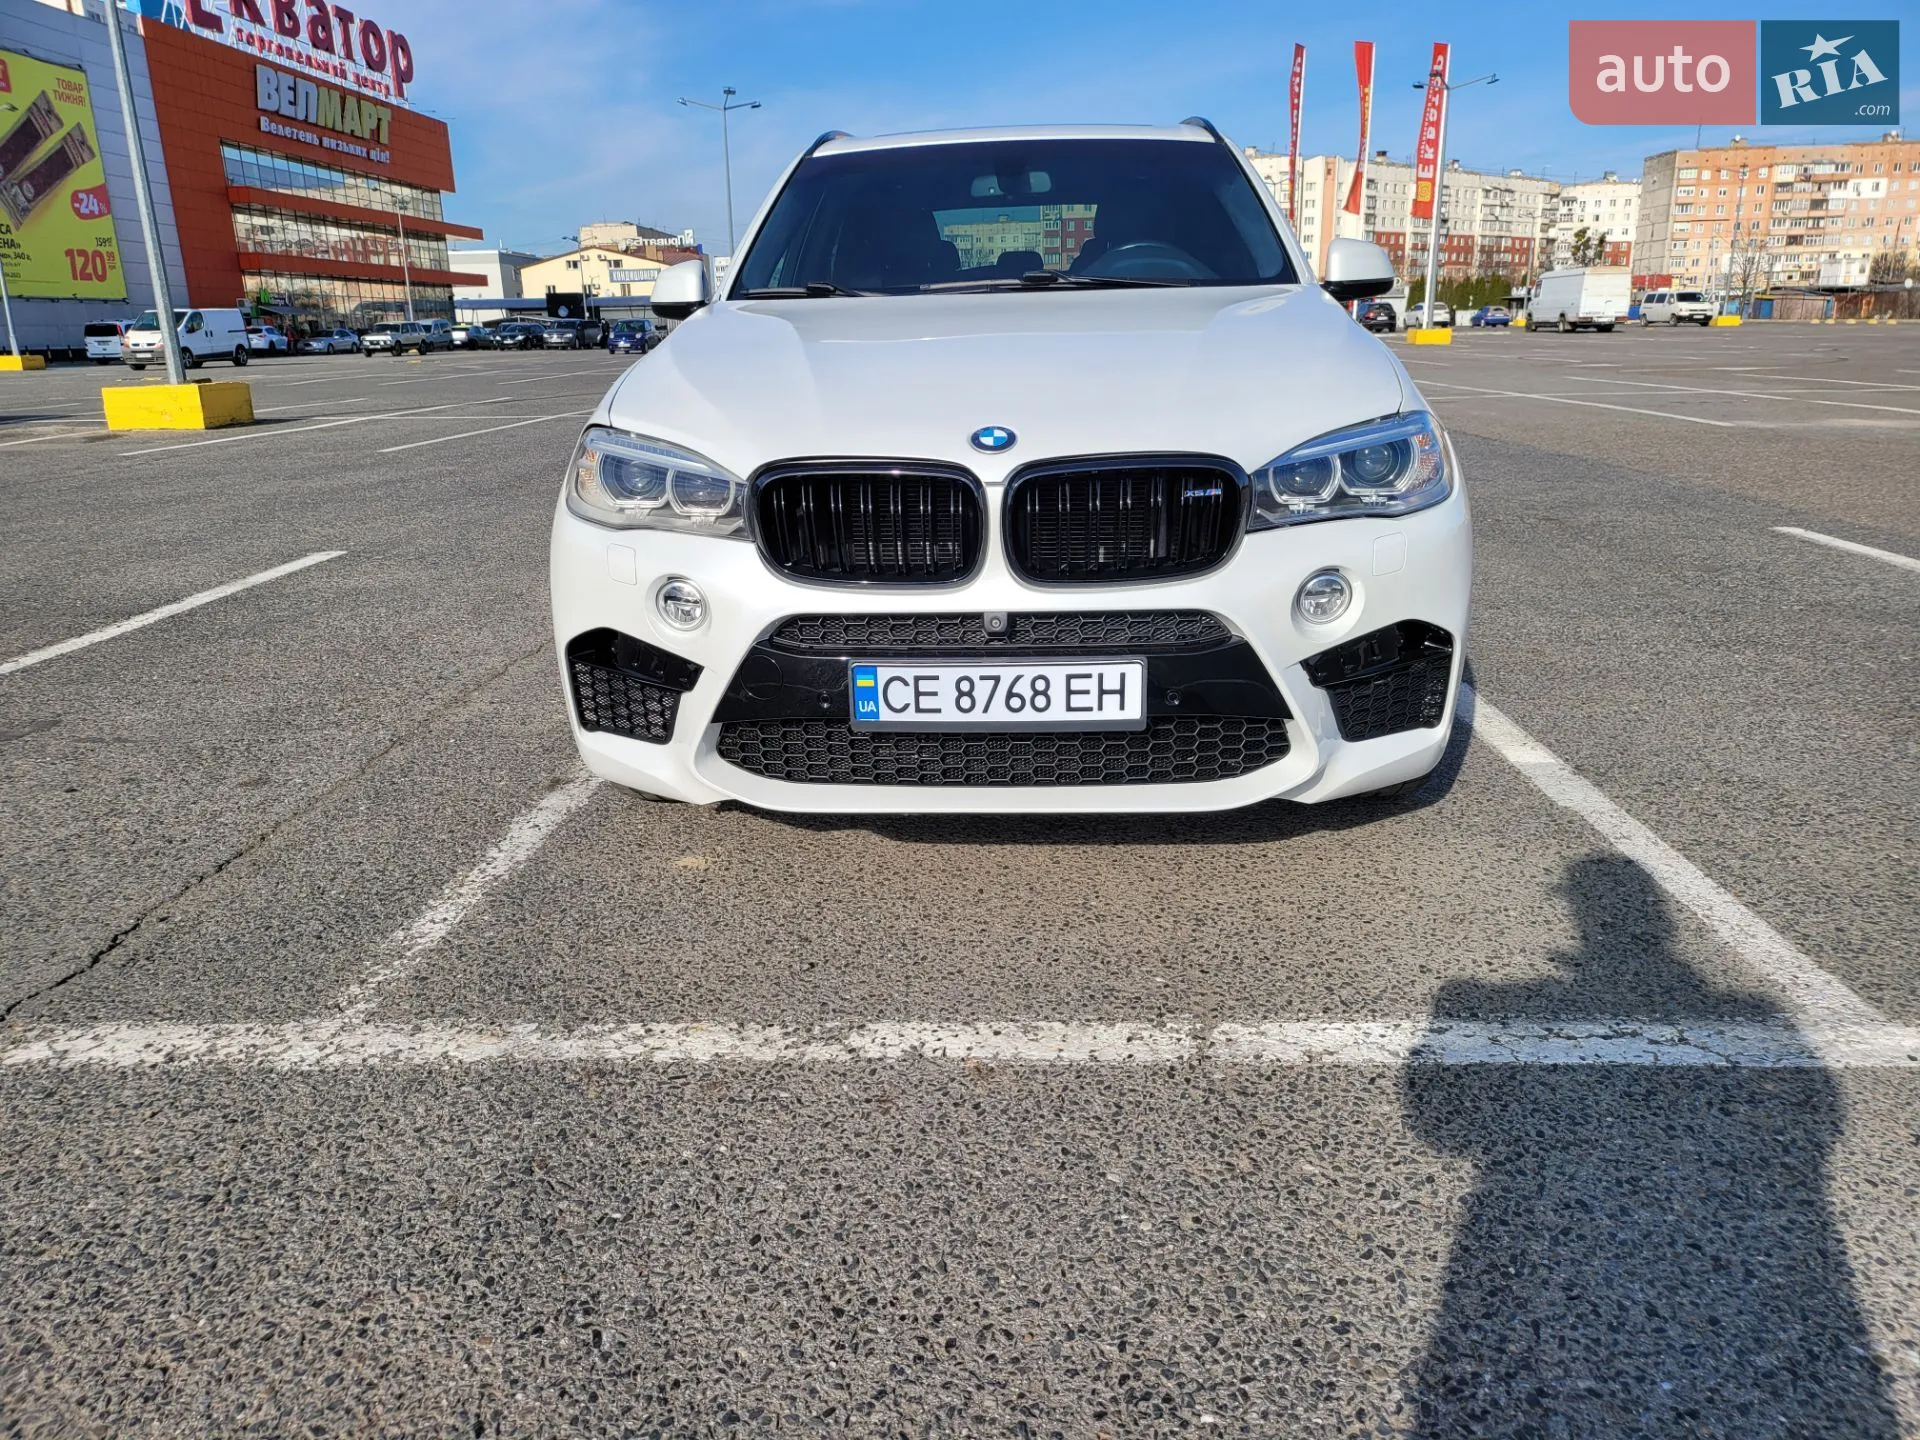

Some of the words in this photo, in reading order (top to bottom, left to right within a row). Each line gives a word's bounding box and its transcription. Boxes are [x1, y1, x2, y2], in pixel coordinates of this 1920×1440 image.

[56, 77, 84, 92] ТОВАР
[256, 64, 392, 145] ВЕЛМАРТ
[259, 115, 320, 146] Велетень
[64, 248, 107, 283] 120
[859, 700, 877, 713] UA
[882, 674, 942, 714] CE
[954, 674, 1051, 714] 8768
[1065, 672, 1126, 712] EH
